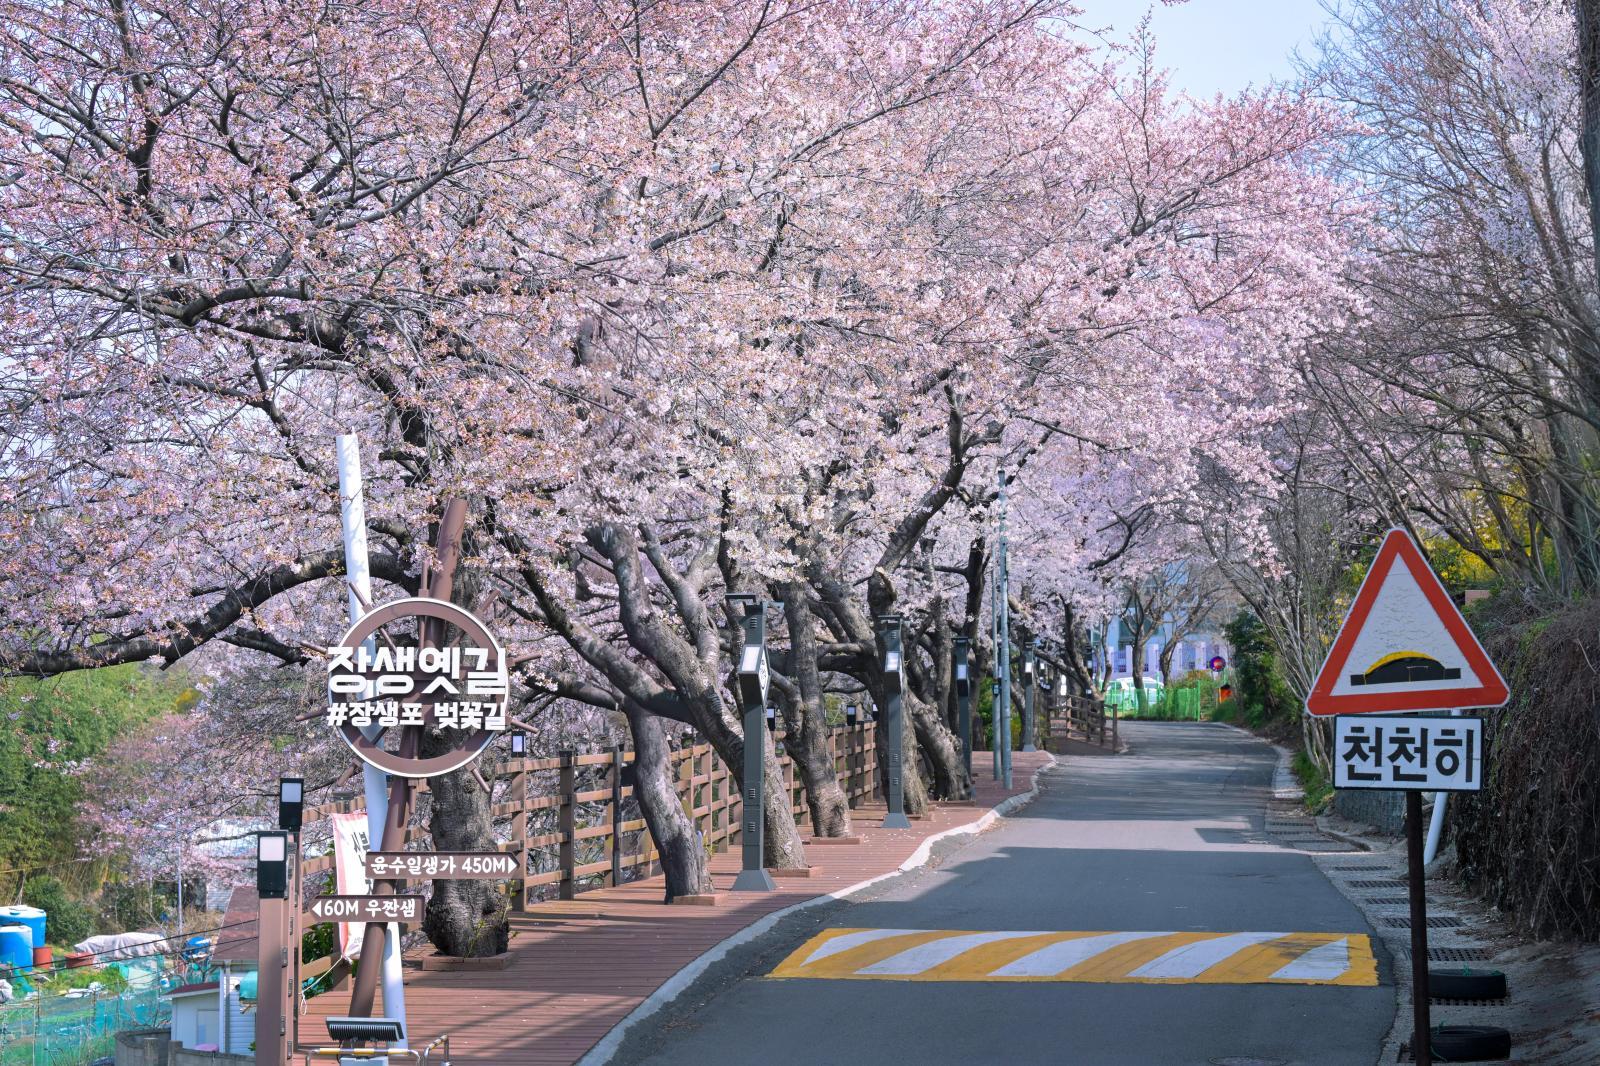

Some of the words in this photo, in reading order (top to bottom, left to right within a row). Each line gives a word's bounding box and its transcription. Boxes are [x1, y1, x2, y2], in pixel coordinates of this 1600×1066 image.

[327, 646, 506, 695] 장생옛길
[327, 702, 425, 728] #장생포
[434, 701, 506, 731] 벚꽃길
[1342, 726, 1475, 783] 천천히
[371, 856, 457, 875] 윤수일생가
[461, 858, 506, 874] 450M
[323, 900, 359, 917] 60M
[365, 899, 416, 919] 우짠샘
